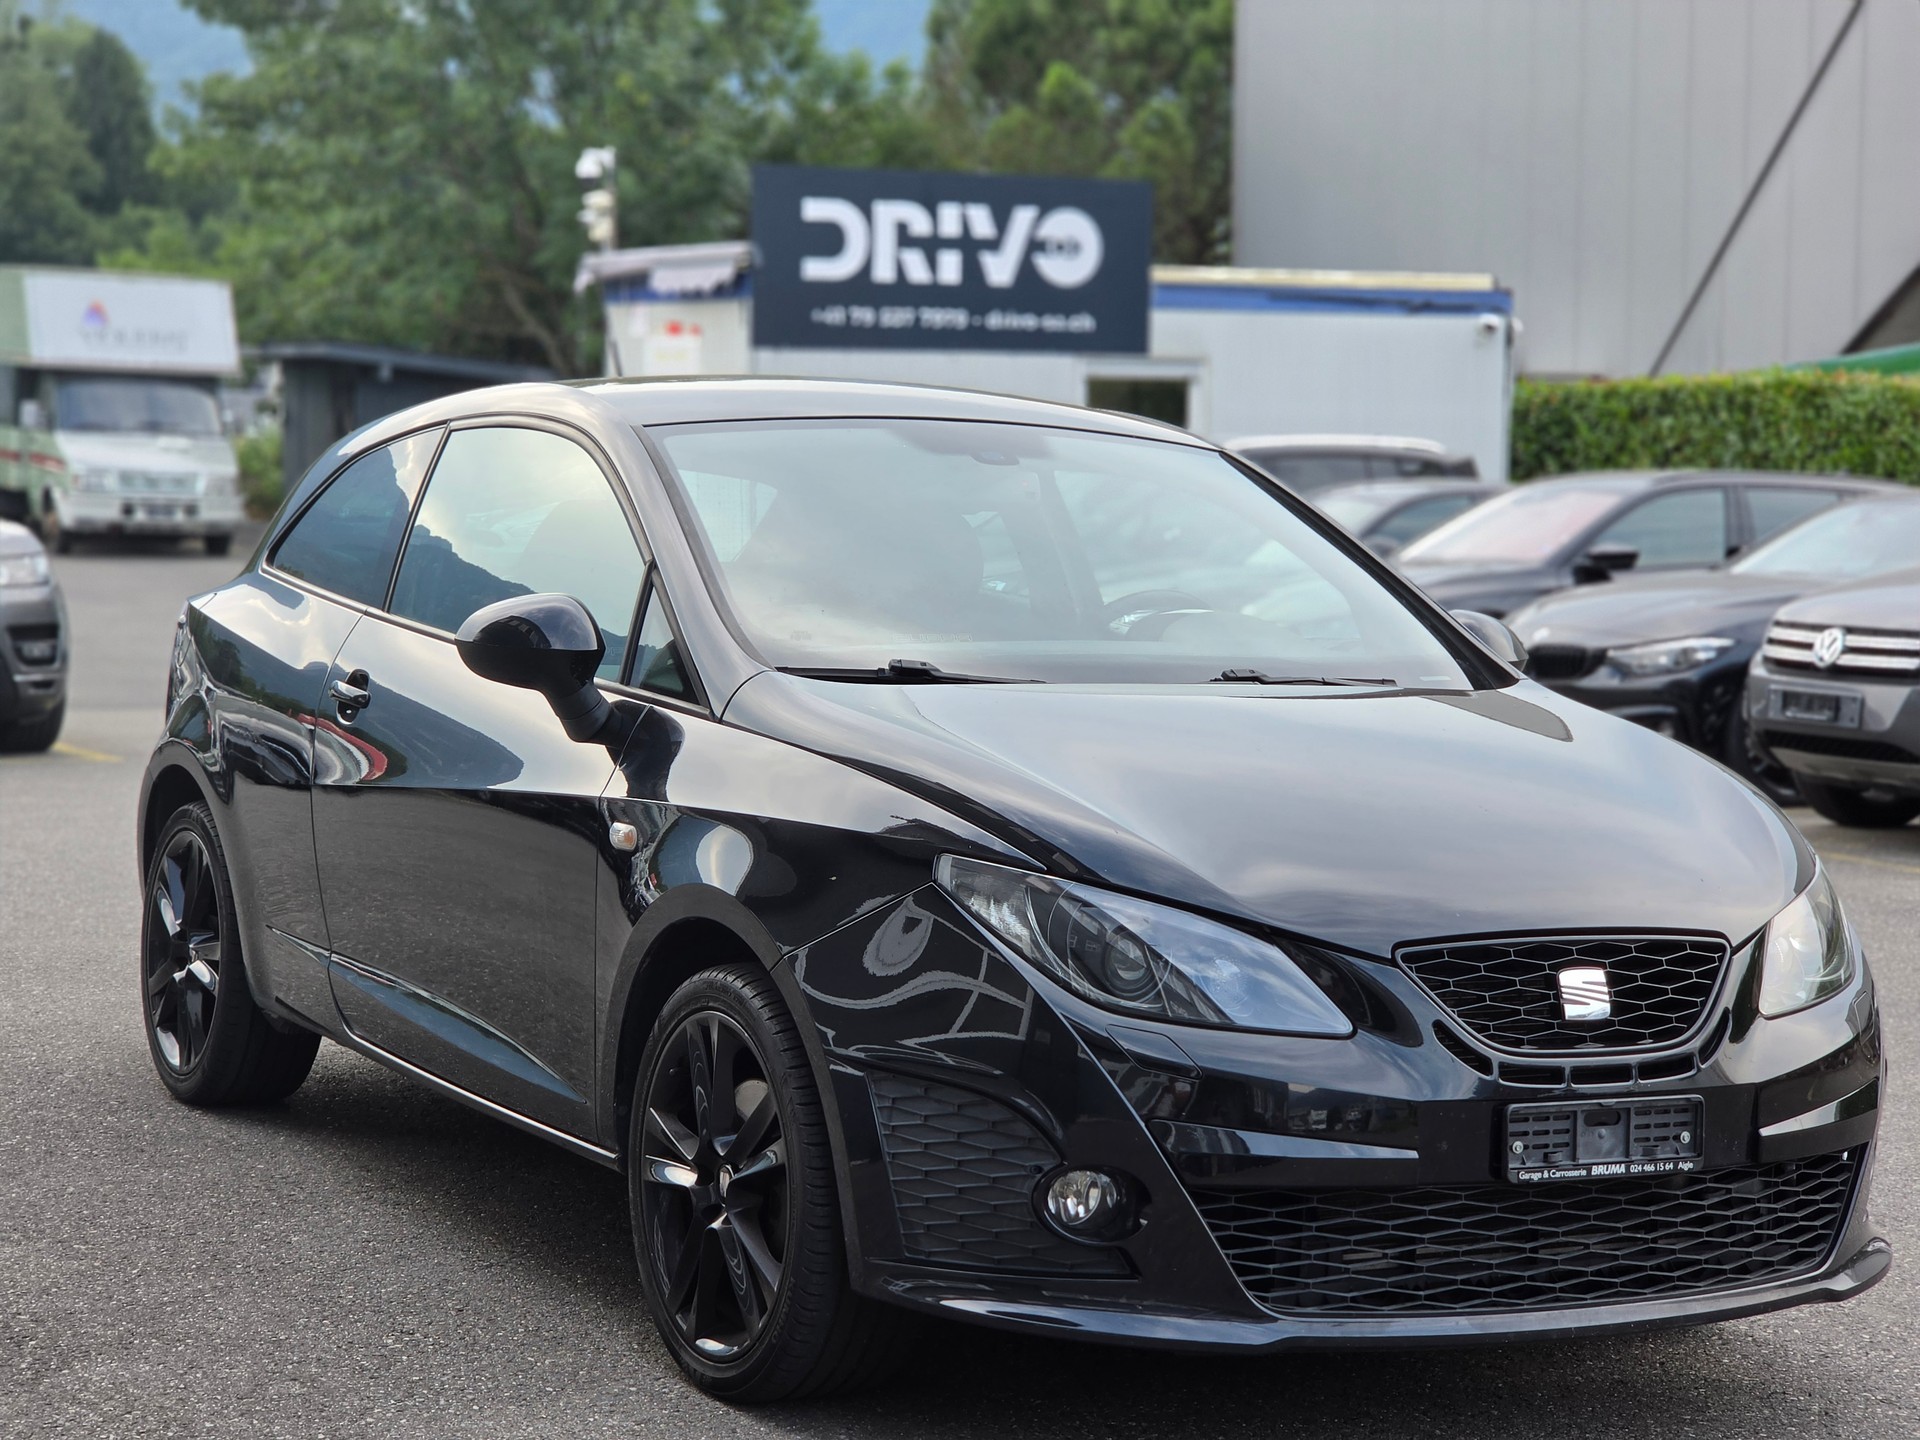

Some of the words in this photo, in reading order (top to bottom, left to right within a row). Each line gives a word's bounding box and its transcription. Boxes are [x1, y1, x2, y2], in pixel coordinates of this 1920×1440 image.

[801, 196, 1103, 289] DRIVO
[1518, 1170, 1542, 1181] Garage
[1543, 1170, 1549, 1178] &
[1550, 1168, 1587, 1178] Carrosserie
[1591, 1163, 1626, 1176] BRUMA
[1630, 1164, 1642, 1173] 024
[1642, 1163, 1655, 1173] 466
[1656, 1162, 1664, 1172] 15
[1664, 1162, 1674, 1171] 64
[1678, 1160, 1694, 1171] Aigle
